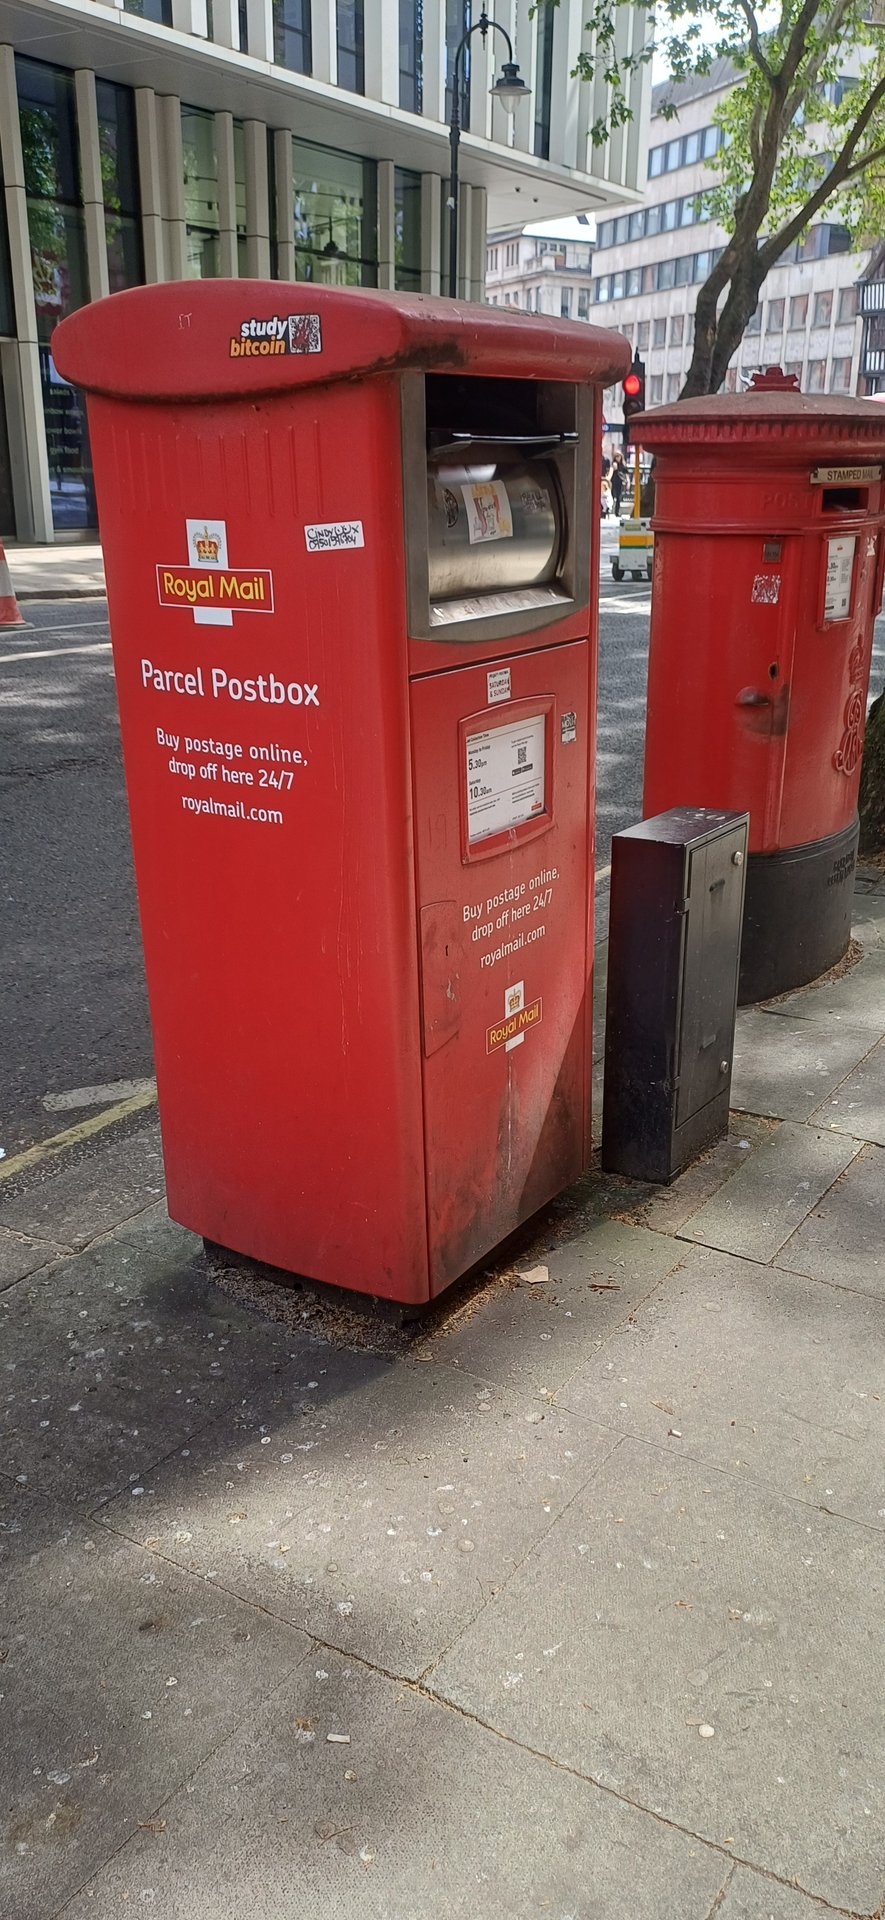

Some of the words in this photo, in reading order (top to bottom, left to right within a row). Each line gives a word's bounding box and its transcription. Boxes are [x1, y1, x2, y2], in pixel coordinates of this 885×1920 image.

[241, 316, 288, 339] study
[230, 336, 285, 357] bitcoin
[827, 470, 861, 481] STAMPED
[163, 572, 214, 602] Royal
[219, 575, 265, 601] Mail
[140, 658, 205, 697] Parcel
[211, 667, 320, 707] Postbox
[156, 727, 180, 752] Buy
[184, 735, 243, 761] postage
[249, 743, 308, 766] online,
[168, 756, 196, 780] drop
[199, 763, 219, 780] off
[222, 765, 254, 786] here
[258, 769, 295, 790] 24/7
[182, 795, 283, 825] royalmail.com
[463, 902, 483, 922] Buy
[486, 882, 526, 911] postage
[529, 866, 560, 890] online,
[472, 921, 493, 942] drop
[496, 911, 510, 929] off
[511, 904, 531, 924] here
[533, 888, 553, 911] 24/7
[480, 924, 546, 969] royalmail.com
[490, 1017, 517, 1045] Royal
[518, 1003, 540, 1029] Mail
